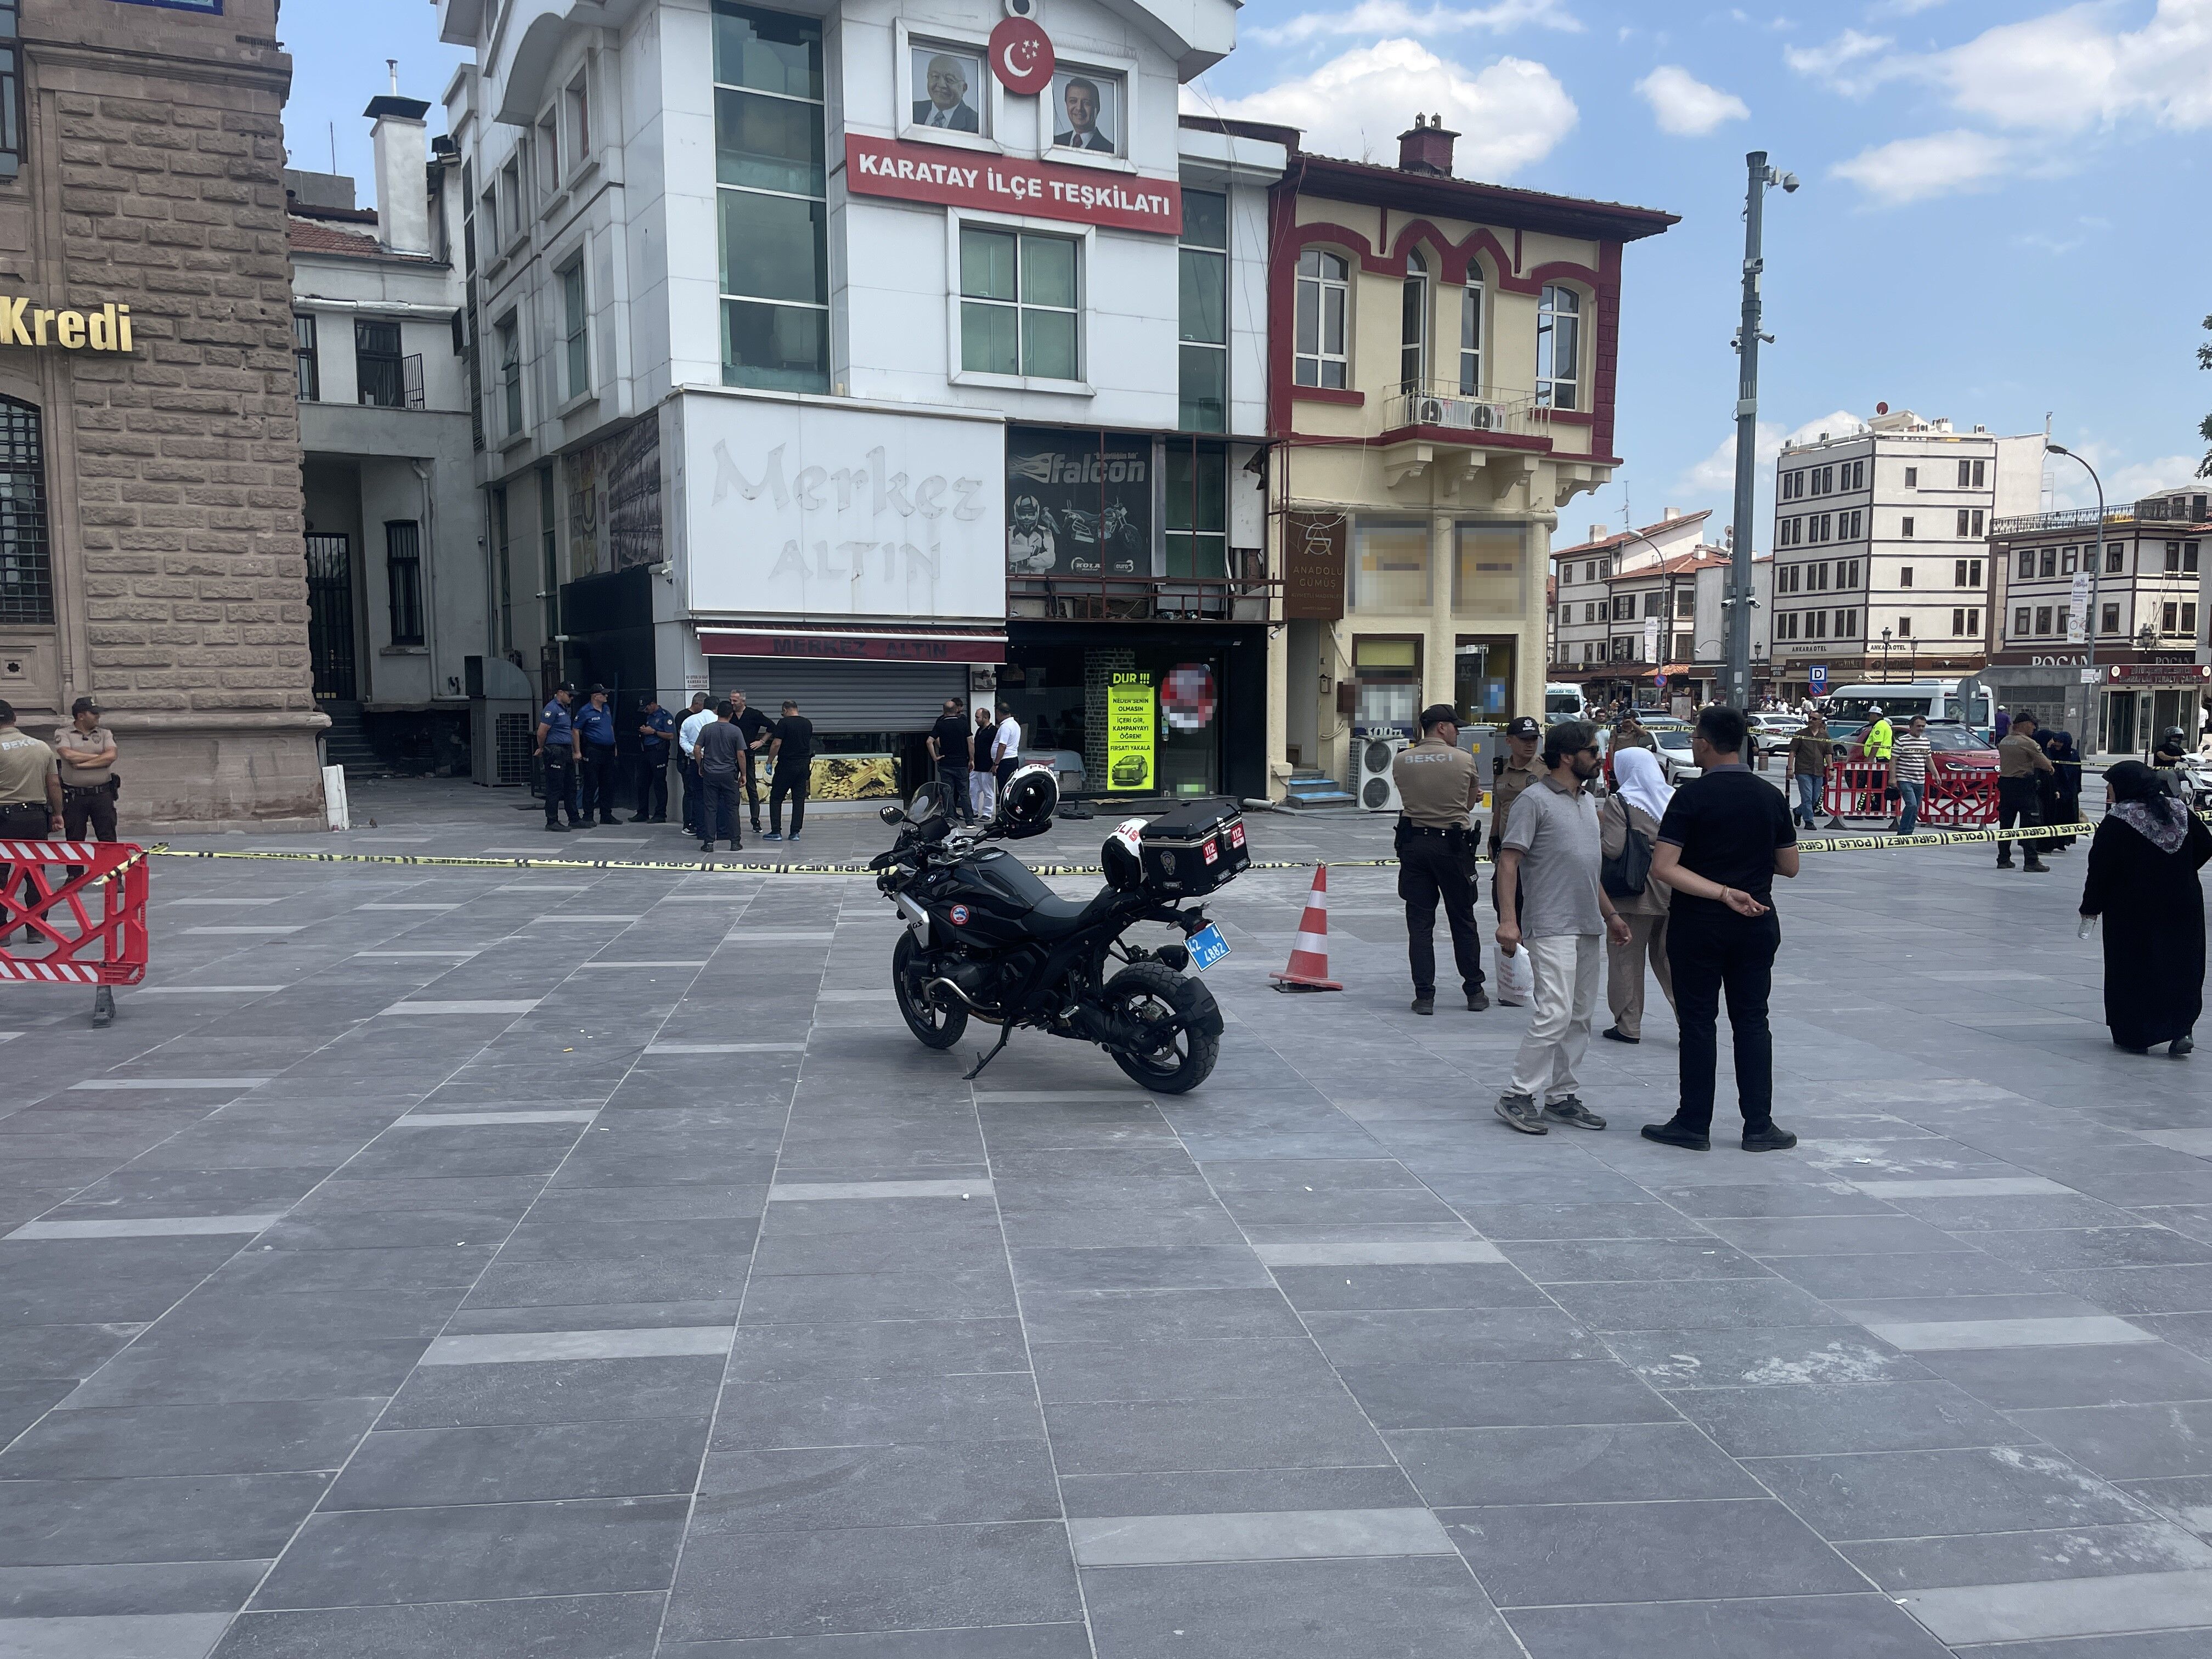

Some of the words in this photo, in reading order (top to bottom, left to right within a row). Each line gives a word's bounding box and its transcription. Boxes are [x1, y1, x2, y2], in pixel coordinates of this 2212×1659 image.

[860, 154, 978, 189] KARATAY
[988, 167, 1041, 201] İLÇE
[1049, 180, 1170, 216] TEŞKİLATI
[0, 296, 133, 352] Kredi
[1051, 453, 1146, 483] falcon
[712, 438, 986, 521] Merkez
[769, 539, 941, 582] ALTIN
[1293, 566, 1343, 575] ANADOLU
[1299, 577, 1336, 589] GÜMÜŞ
[774, 637, 866, 657] MERKEZ
[886, 641, 947, 659] ALTIN
[1113, 673, 1136, 684] DUR
[1140, 673, 1150, 684] !!!
[1815, 670, 1822, 679] D
[1232, 827, 1243, 840] 112
[1838, 838, 1872, 848] POLİS
[1887, 835, 1938, 846] GİRİLMEZ
[1205, 843, 1215, 856] 112
[912, 920, 923, 929] GS
[1188, 939, 1201, 952] 42
[1211, 927, 1220, 939] A
[1204, 942, 1226, 962] 4882
